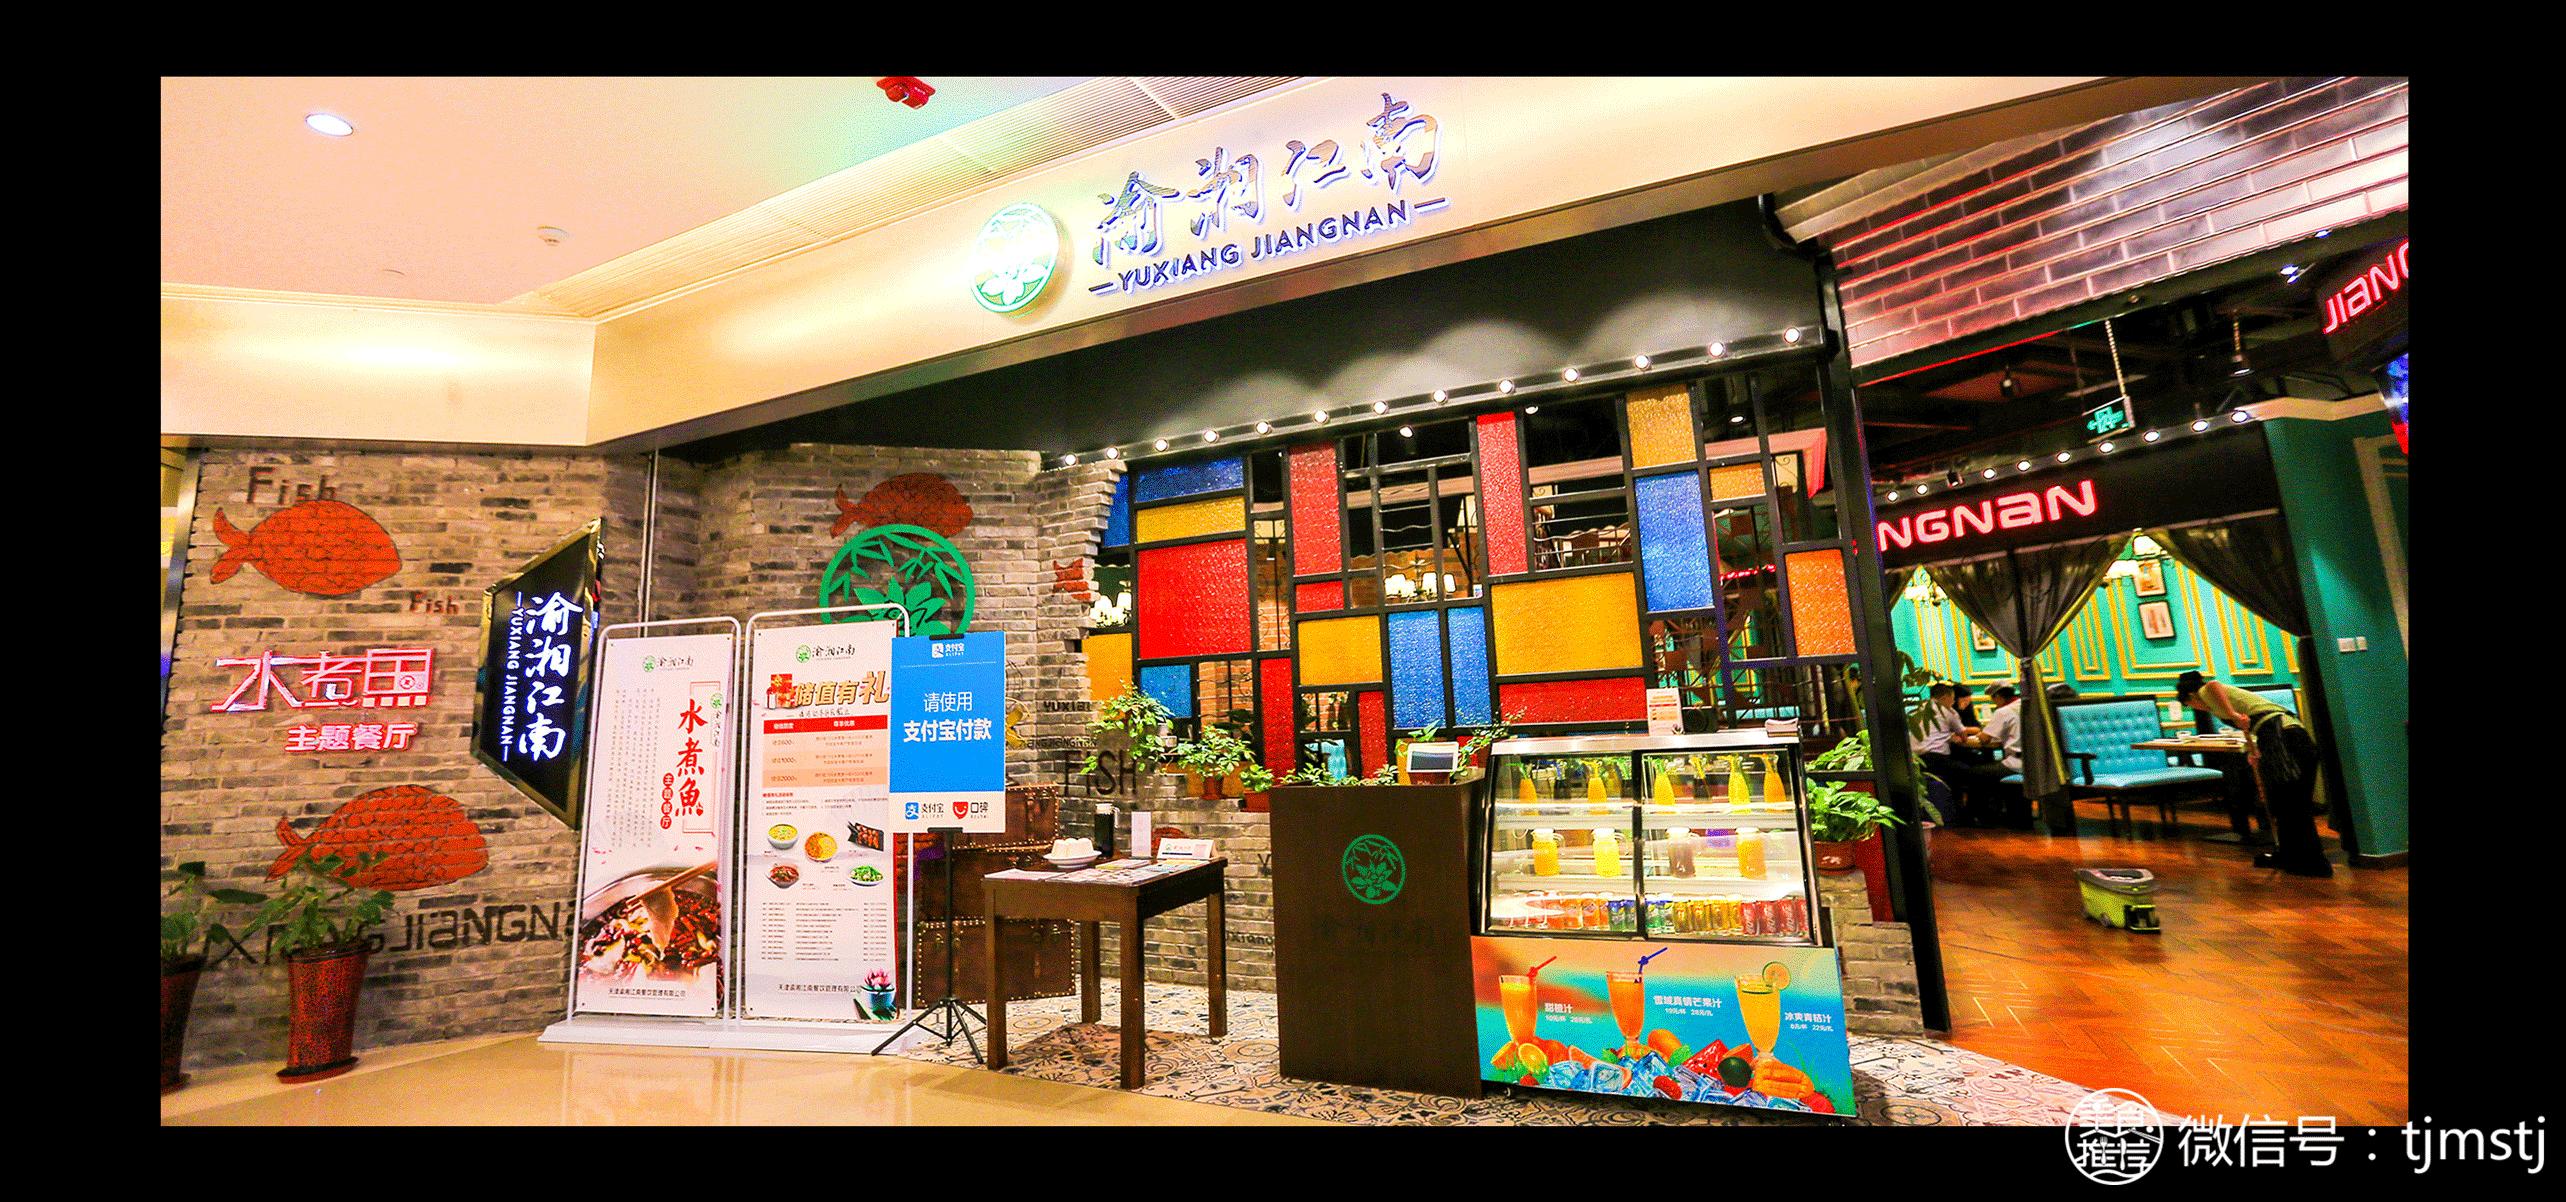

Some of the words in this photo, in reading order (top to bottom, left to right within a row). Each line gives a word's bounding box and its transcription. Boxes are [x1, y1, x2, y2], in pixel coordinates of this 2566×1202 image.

[1093, 92, 1443, 266] 渝湘江南
[1117, 243, 1241, 295] YUXIANG
[1250, 199, 1410, 260] JIANGNAN
[246, 466, 339, 506] Fish
[409, 592, 461, 617] Fish
[505, 608, 526, 671] YUXIANG
[520, 591, 584, 762] 渝湘江南
[796, 671, 890, 707] 储值有礼
[498, 675, 518, 747] JIANGNAN
[923, 692, 973, 712] 请使用
[285, 722, 418, 752] 主题餐厅
[903, 718, 992, 743] 支付宝付款
[1064, 749, 1137, 796] FISH
